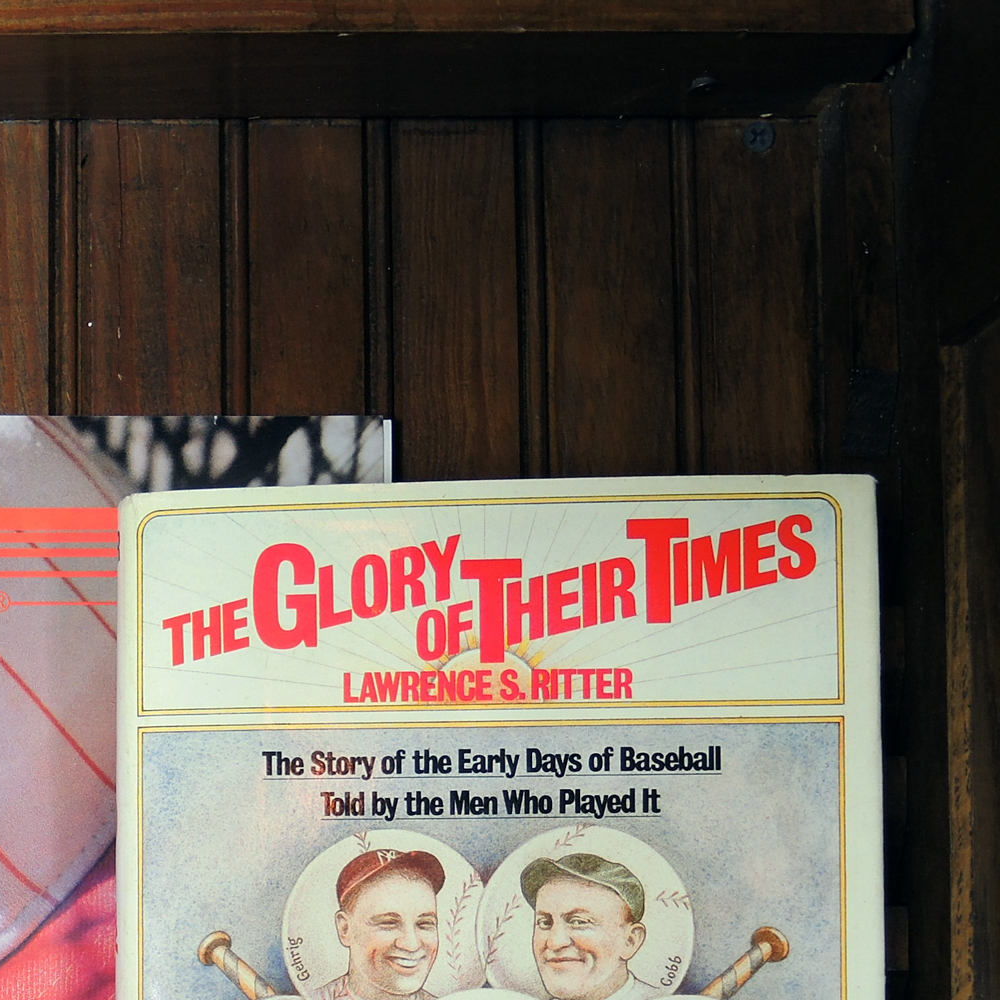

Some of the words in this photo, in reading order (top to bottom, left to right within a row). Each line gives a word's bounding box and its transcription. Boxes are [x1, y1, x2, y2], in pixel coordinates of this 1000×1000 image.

[162, 597, 250, 667] THE
[252, 533, 462, 650] GLORY
[415, 600, 474, 662] OF
[460, 558, 638, 664] THEIR
[625, 513, 818, 624] TIMES
[343, 669, 493, 703] LAWRENCE
[499, 668, 526, 701] S.
[531, 667, 634, 700] RITTER
[262, 751, 304, 776] The
[310, 750, 376, 780] Story
[380, 748, 406, 774] of
[412, 748, 456, 774] the
[457, 748, 520, 778] Early
[526, 747, 583, 778] Days
[588, 746, 614, 772] of
[619, 745, 723, 772] Baseball
[320, 791, 365, 816] Told
[371, 790, 399, 822] by
[404, 790, 444, 816] the
[449, 790, 498, 816] Men
[502, 789, 553, 815] Who
[558, 788, 636, 819] Played
[641, 787, 662, 814] It
[287, 936, 310, 982] Gehrig
[660, 955, 682, 987] Cobb
